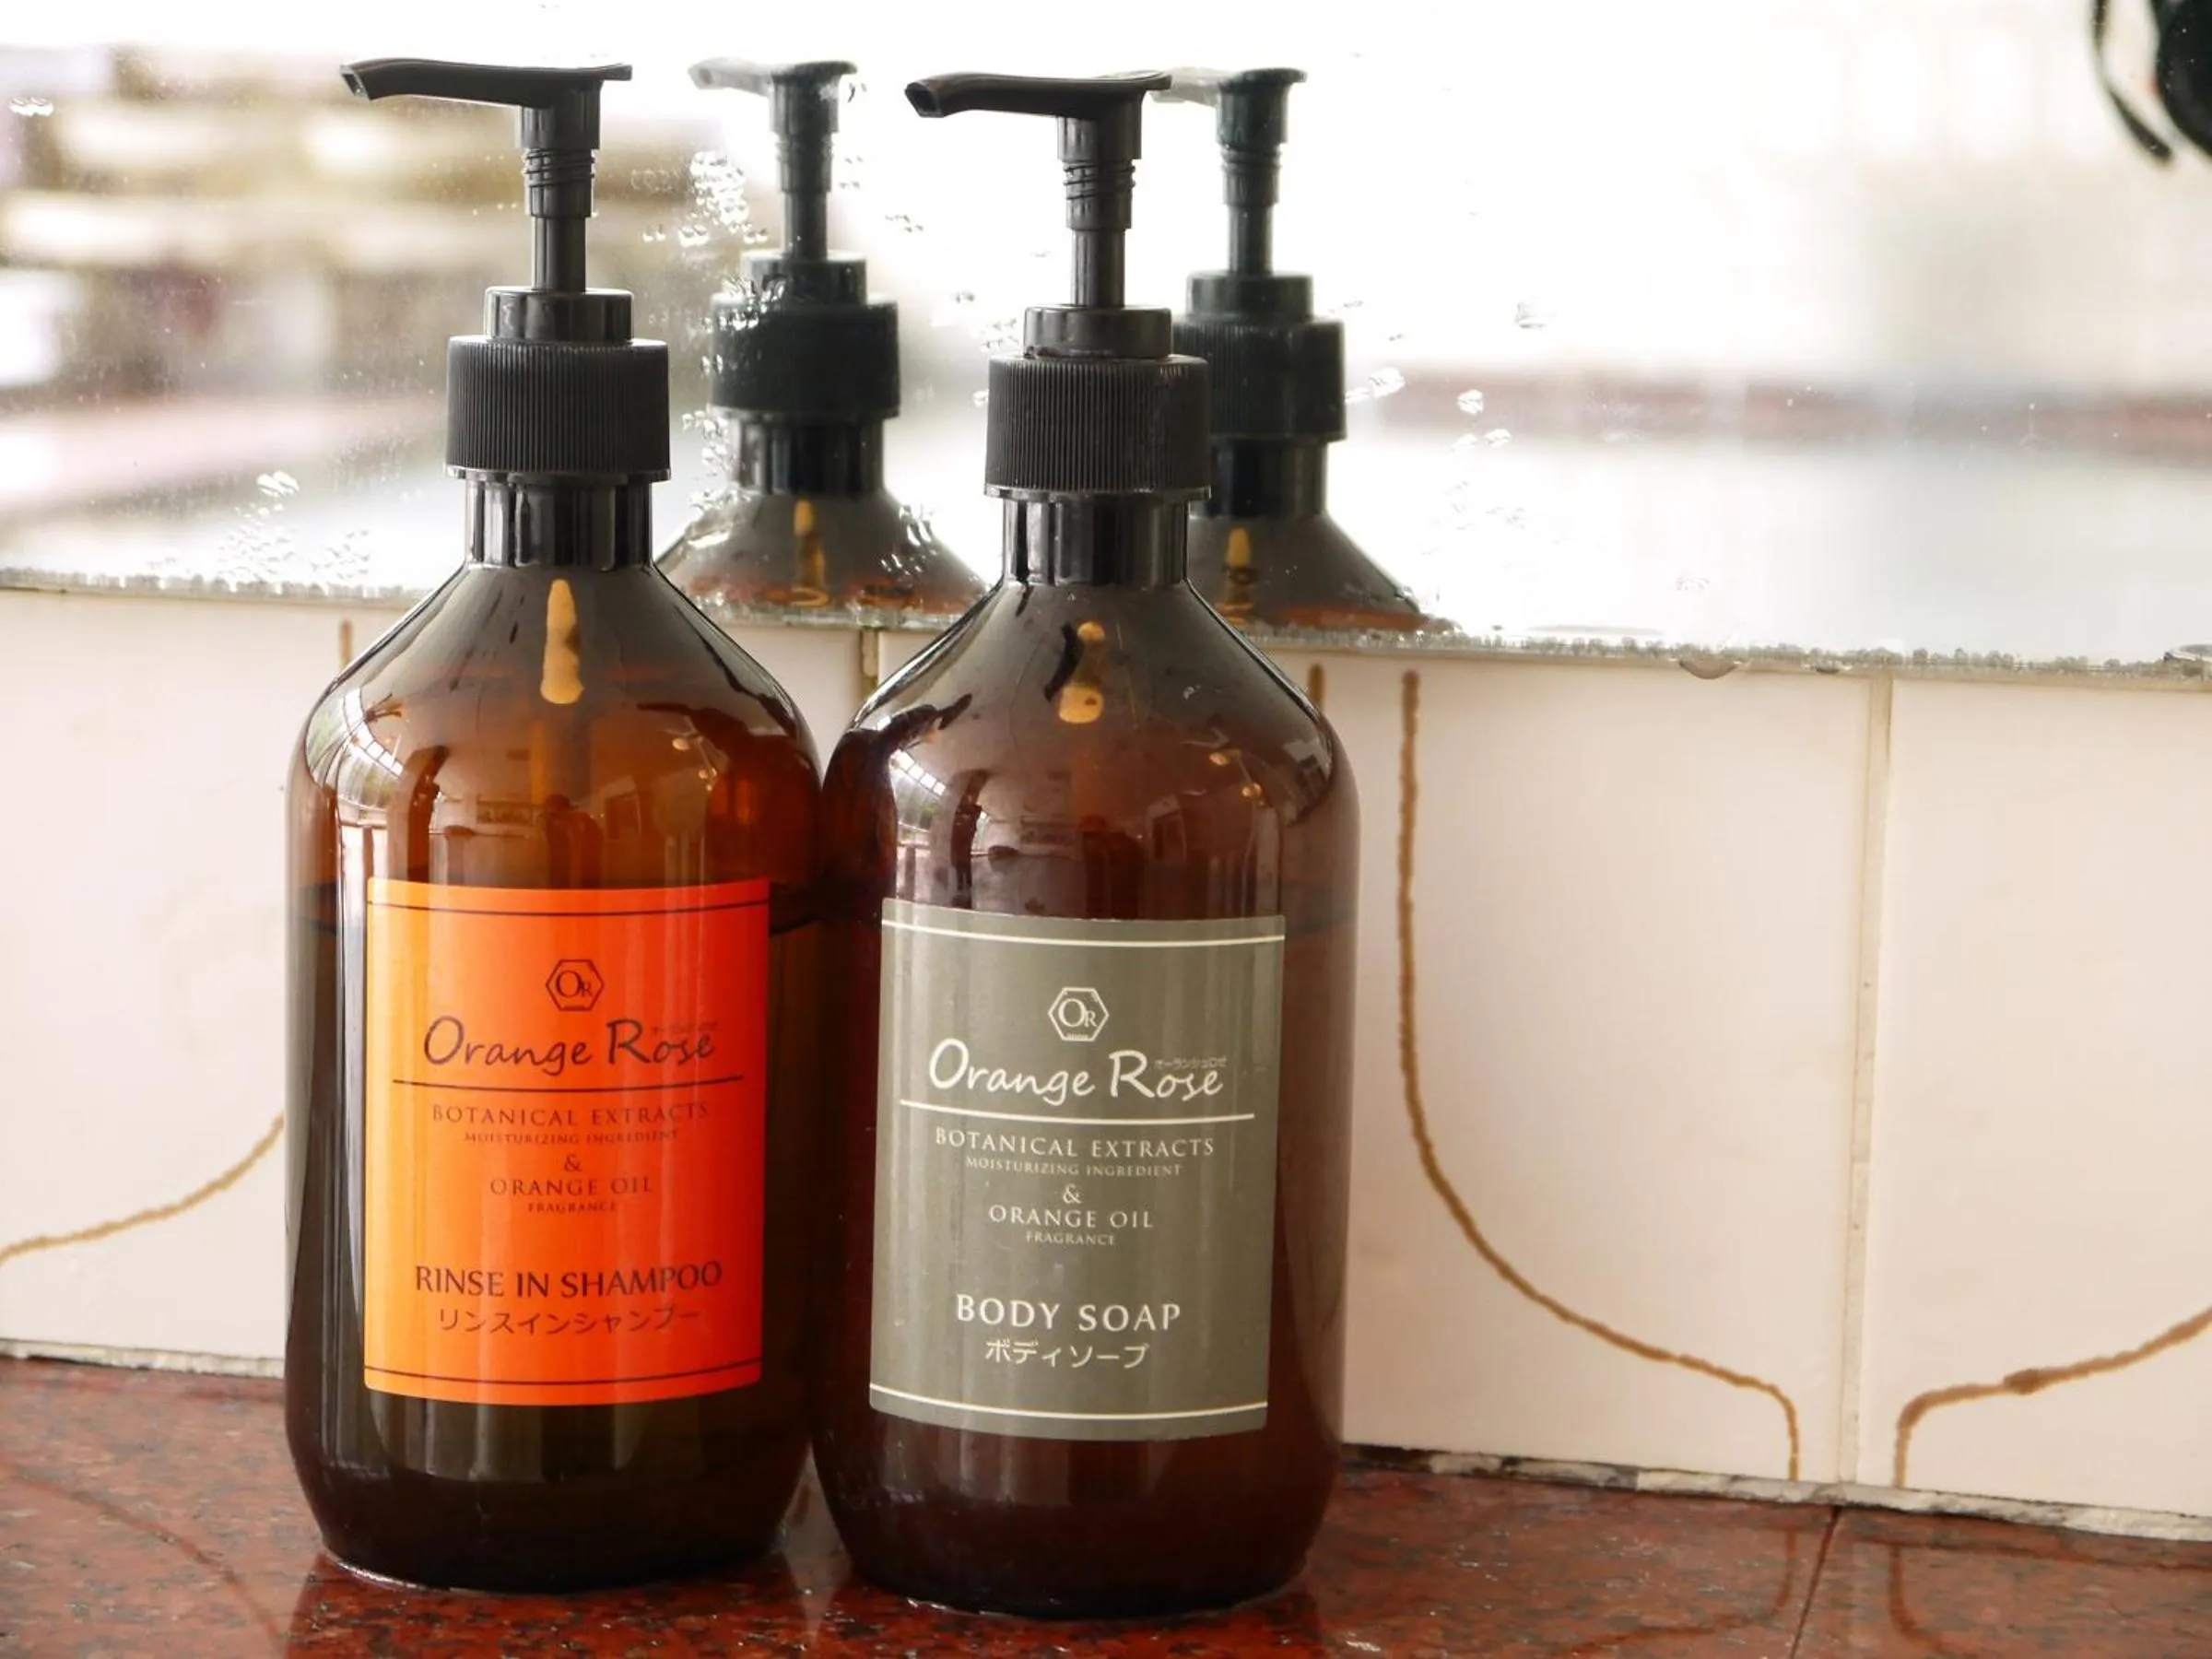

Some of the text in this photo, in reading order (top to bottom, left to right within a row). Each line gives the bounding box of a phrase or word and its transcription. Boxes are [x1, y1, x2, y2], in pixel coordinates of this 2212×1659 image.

[424, 1016, 716, 1076] Orange Rose
[928, 1038, 1224, 1106] Orange Rose
[432, 1101, 710, 1127] BOTANICAL EXTRACTS
[465, 1130, 580, 1145] MOISTURIZING
[935, 1126, 1215, 1159] BOTANICAL EXTRACTS
[563, 1154, 582, 1172] &
[965, 1156, 1183, 1178] MOISTURIZING INGREDIENT
[490, 1175, 653, 1195] ORANGE OIL
[1062, 1183, 1084, 1204] &
[527, 1201, 618, 1213] FRAGRANCE
[988, 1205, 1154, 1229] ORANGE OIL
[1025, 1230, 1116, 1246] FRAGRANCE
[415, 1260, 724, 1299] RINSE IN SHAMPOO
[439, 1302, 700, 1336] リンスインシャンプー
[956, 1293, 1182, 1332] BODY SOAP
[985, 1336, 1150, 1369] ボディソープ
